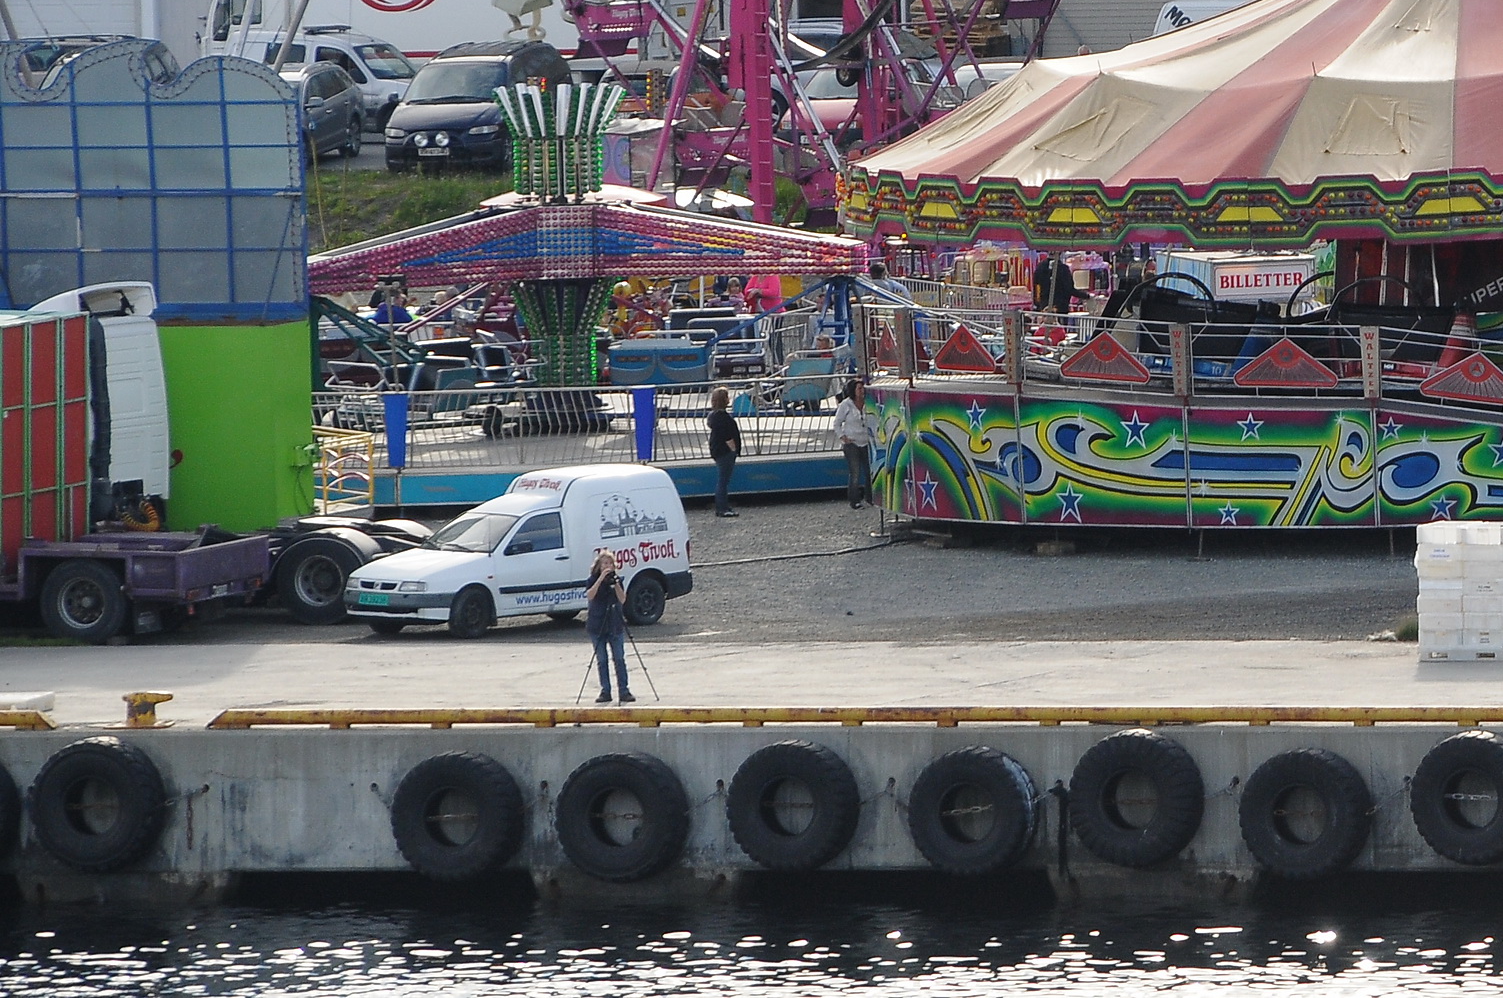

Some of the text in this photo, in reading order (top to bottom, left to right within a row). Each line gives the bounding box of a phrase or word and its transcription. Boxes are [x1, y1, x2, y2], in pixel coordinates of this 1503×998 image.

[1219, 272, 1303, 289] BILLETTER
[1363, 332, 1375, 395] WALTZER
[594, 546, 637, 569] gos
[515, 589, 588, 605] www.hugostivo
